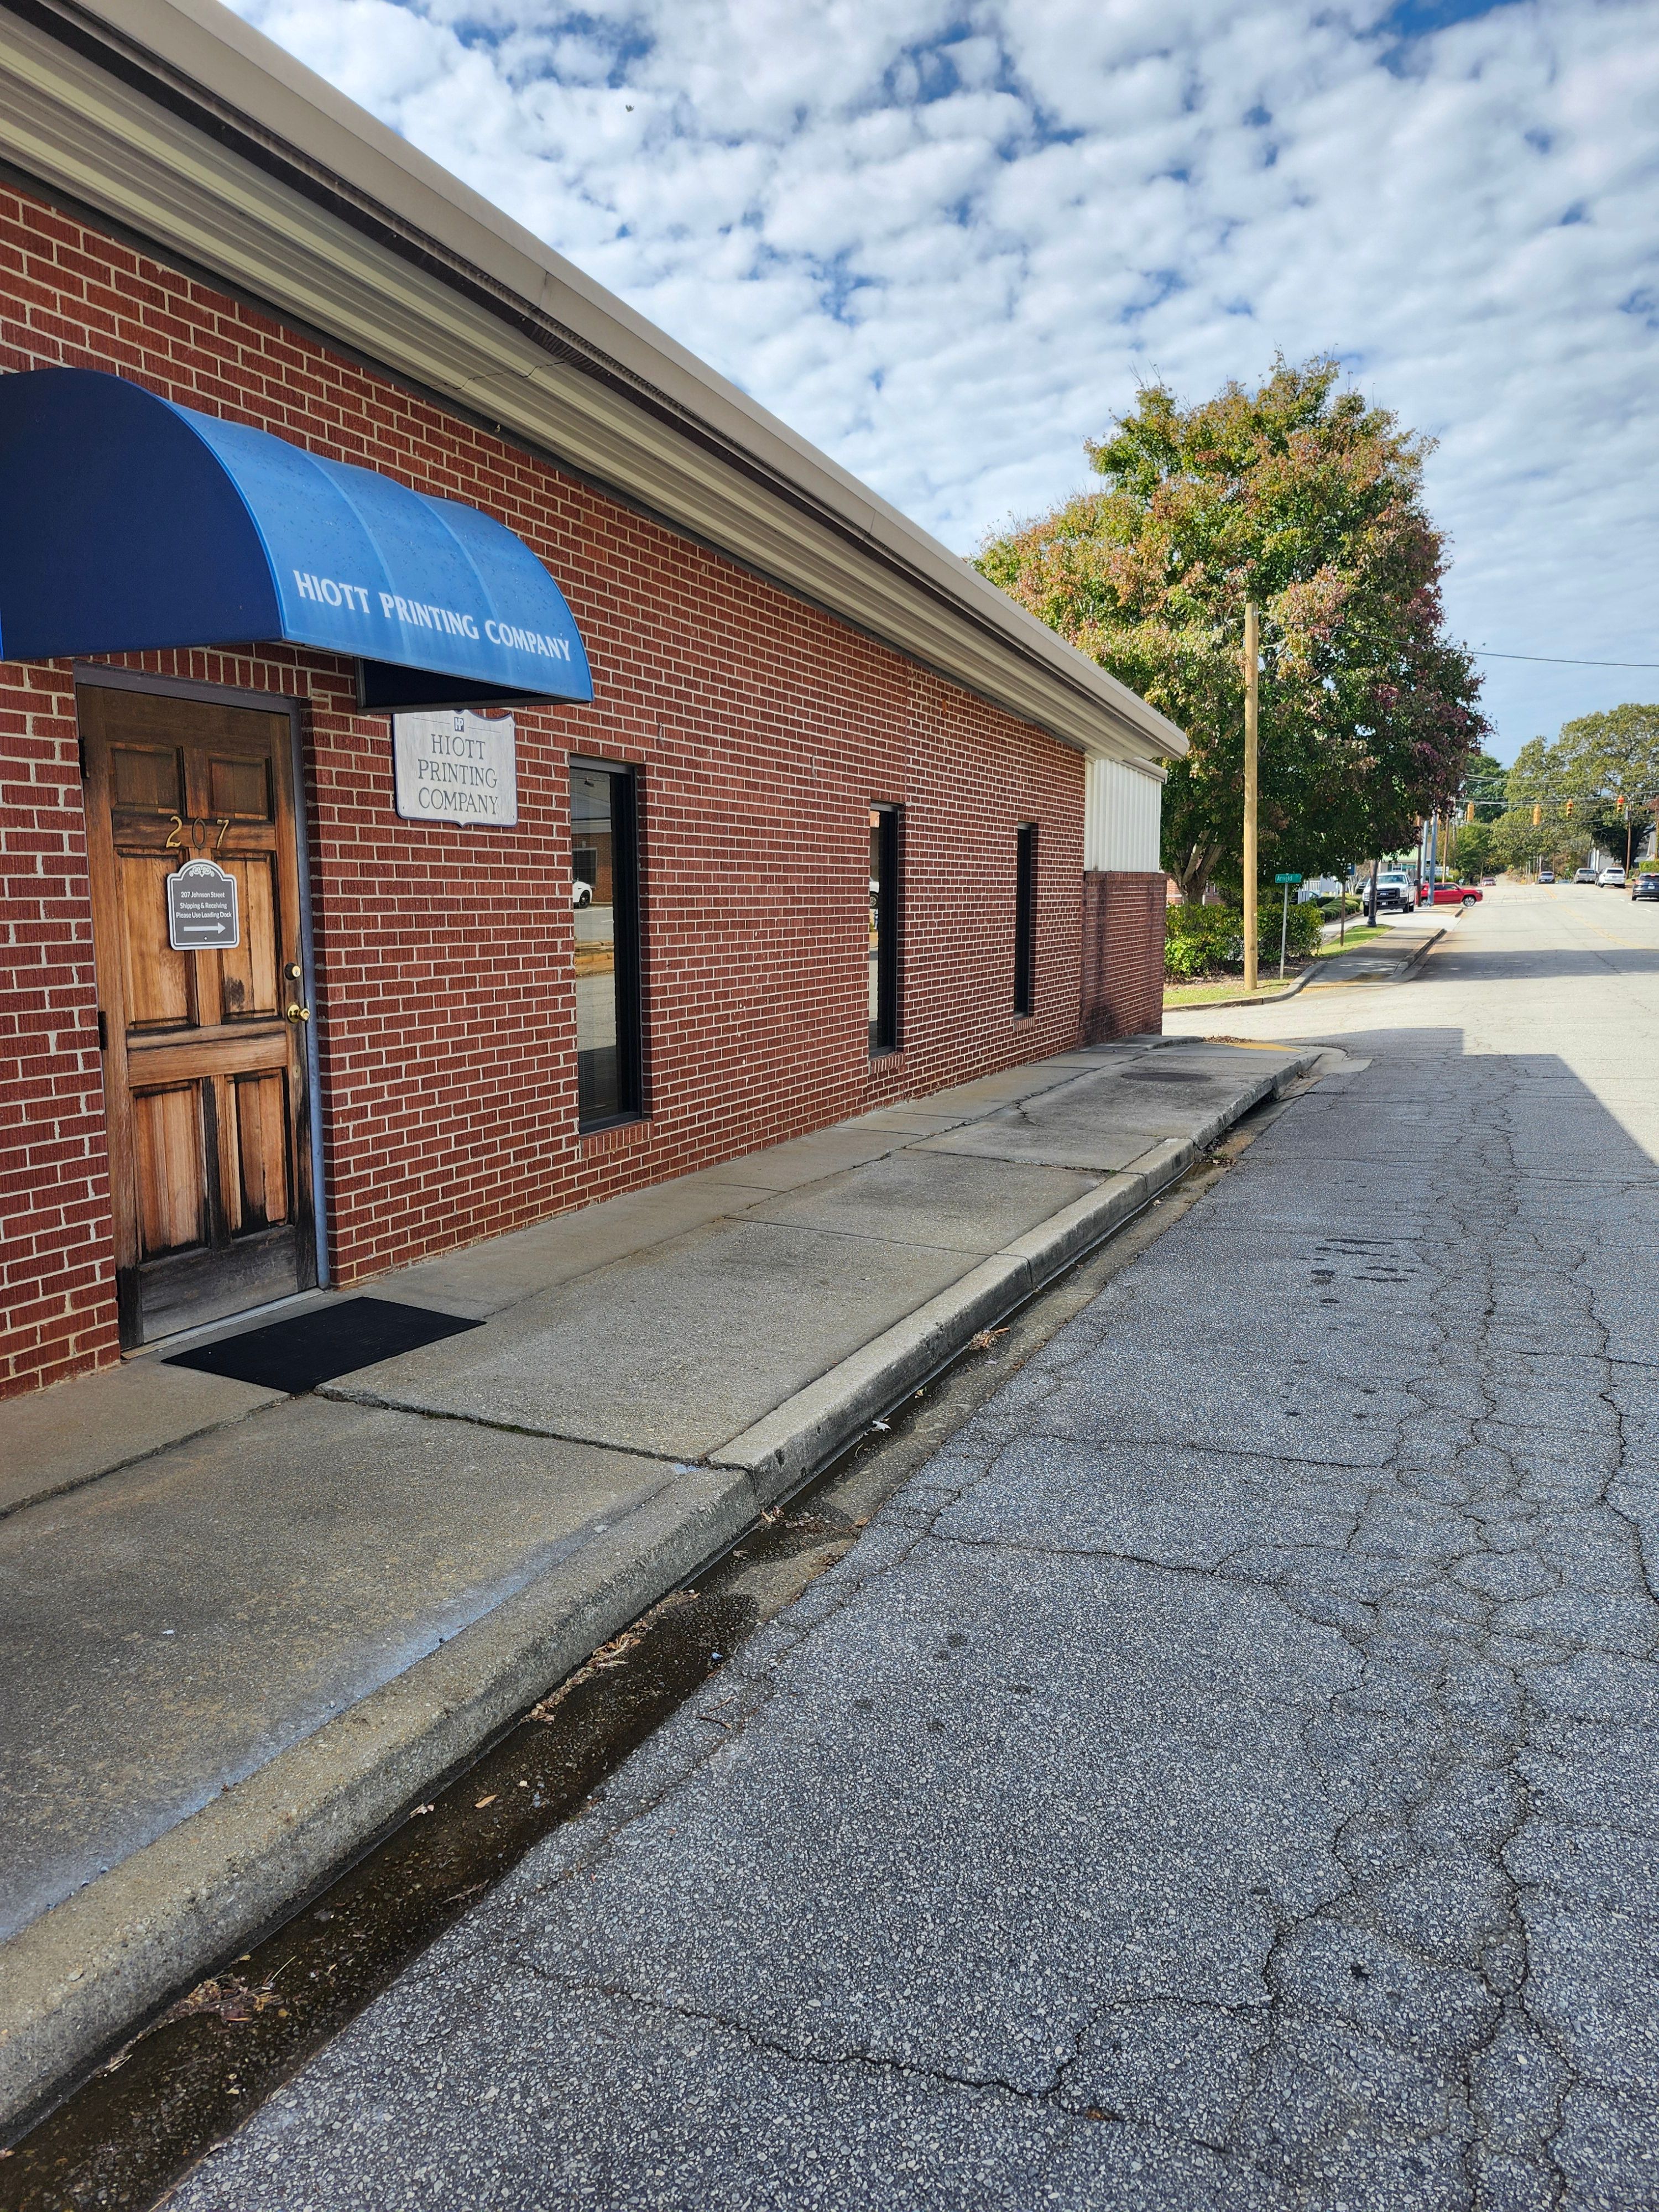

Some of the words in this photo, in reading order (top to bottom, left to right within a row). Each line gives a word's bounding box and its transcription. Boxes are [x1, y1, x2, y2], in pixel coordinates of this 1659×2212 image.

[293, 570, 371, 614] HIOTT
[378, 592, 479, 639] PRINTING
[485, 620, 571, 661] COMPANY
[455, 717, 463, 731] HP
[431, 734, 486, 760] HIOTT
[418, 759, 497, 788] PRINTING
[419, 787, 498, 815] COMPANY
[166, 816, 229, 849] 207
